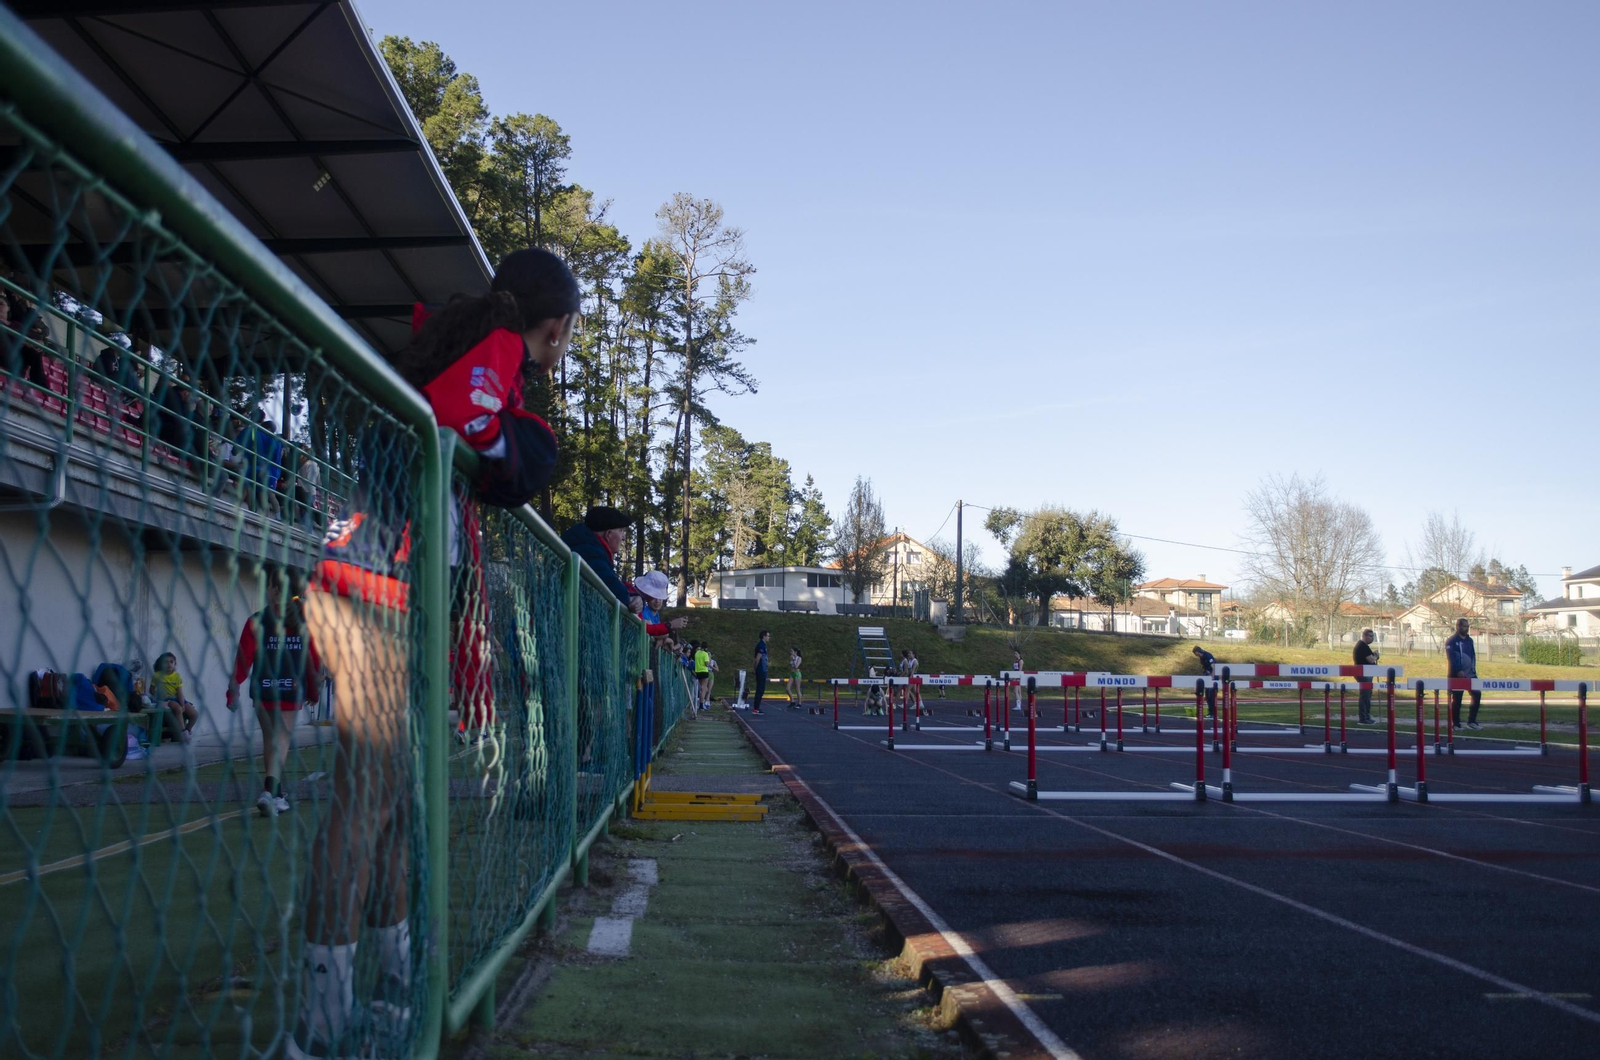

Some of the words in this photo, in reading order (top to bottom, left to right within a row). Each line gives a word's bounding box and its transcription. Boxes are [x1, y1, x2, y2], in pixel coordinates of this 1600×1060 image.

[1290, 667, 1329, 675] MONDO
[1097, 677, 1136, 685] MONDO
[1483, 681, 1520, 689] MONDO
